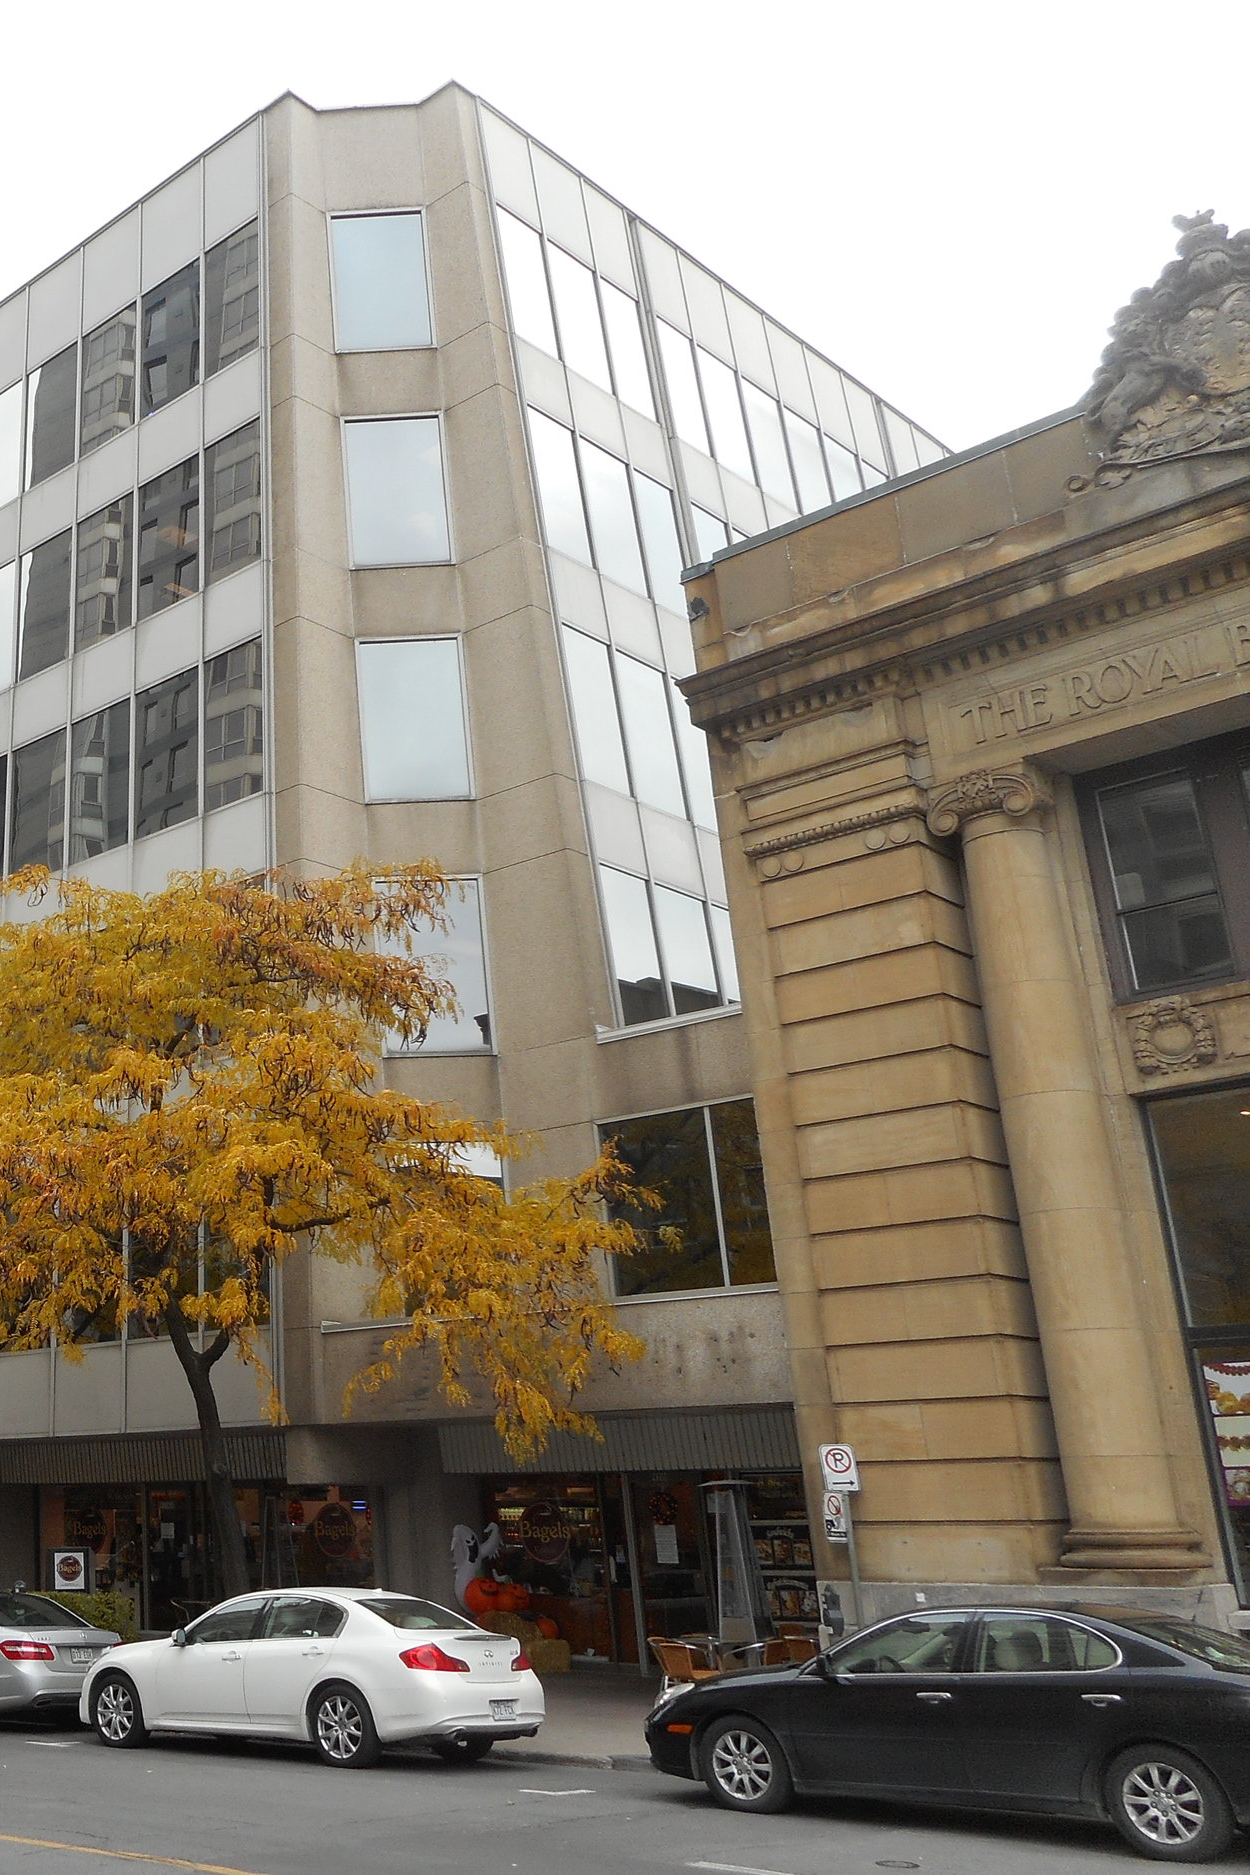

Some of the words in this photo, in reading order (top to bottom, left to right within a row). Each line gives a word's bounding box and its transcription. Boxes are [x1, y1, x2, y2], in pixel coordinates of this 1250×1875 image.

[960, 683, 1053, 745] THE
[1061, 634, 1220, 718] ROYAL
[833, 1452, 844, 1469] P
[73, 1521, 107, 1539] Bagels
[315, 1520, 357, 1540] Bagels
[520, 1521, 571, 1543] Bagels
[57, 1563, 82, 1574] Bagels
